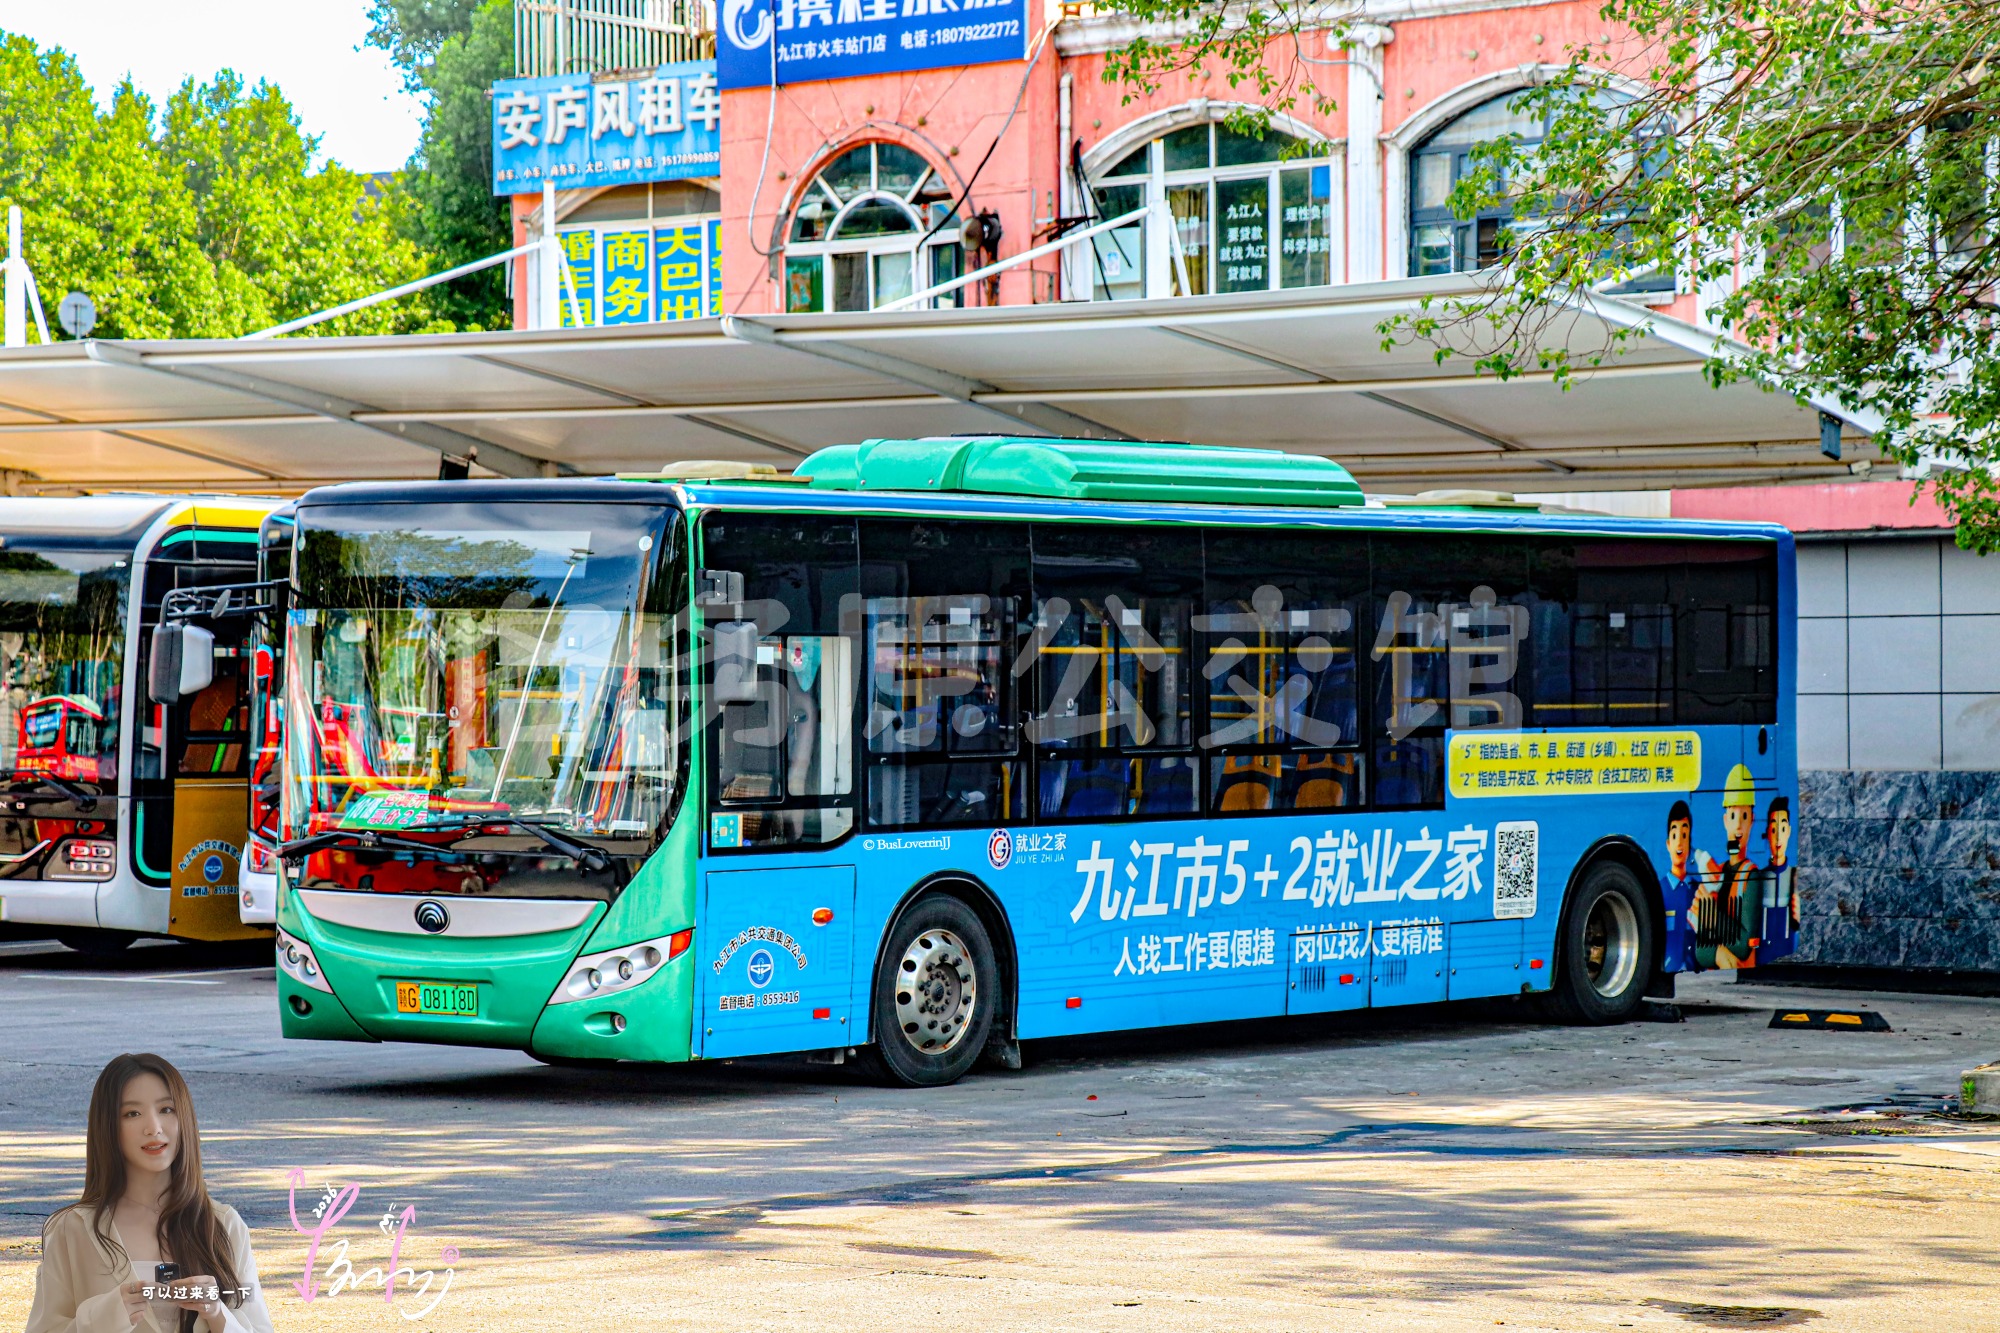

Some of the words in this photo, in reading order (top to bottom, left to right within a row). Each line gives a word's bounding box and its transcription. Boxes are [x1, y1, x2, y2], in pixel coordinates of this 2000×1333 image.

[777, 34, 887, 62] 九江市火车站门店
[498, 73, 720, 149] 安庐风租车
[1227, 203, 1262, 220] 九江人
[1227, 226, 1263, 242] 要贷款
[1015, 832, 1067, 852] 就业之家
[1015, 855, 1026, 864] JIU
[1028, 854, 1037, 863] YE
[1041, 854, 1053, 863] ZHI
[1054, 853, 1065, 862] JIA
[1070, 824, 1489, 924] 九江市5+2就业之家
[712, 926, 808, 975] 九江市公共交通集团公司
[1113, 928, 1275, 977] 人找工作更便捷
[1294, 920, 1444, 964] 岗位找人更精准
